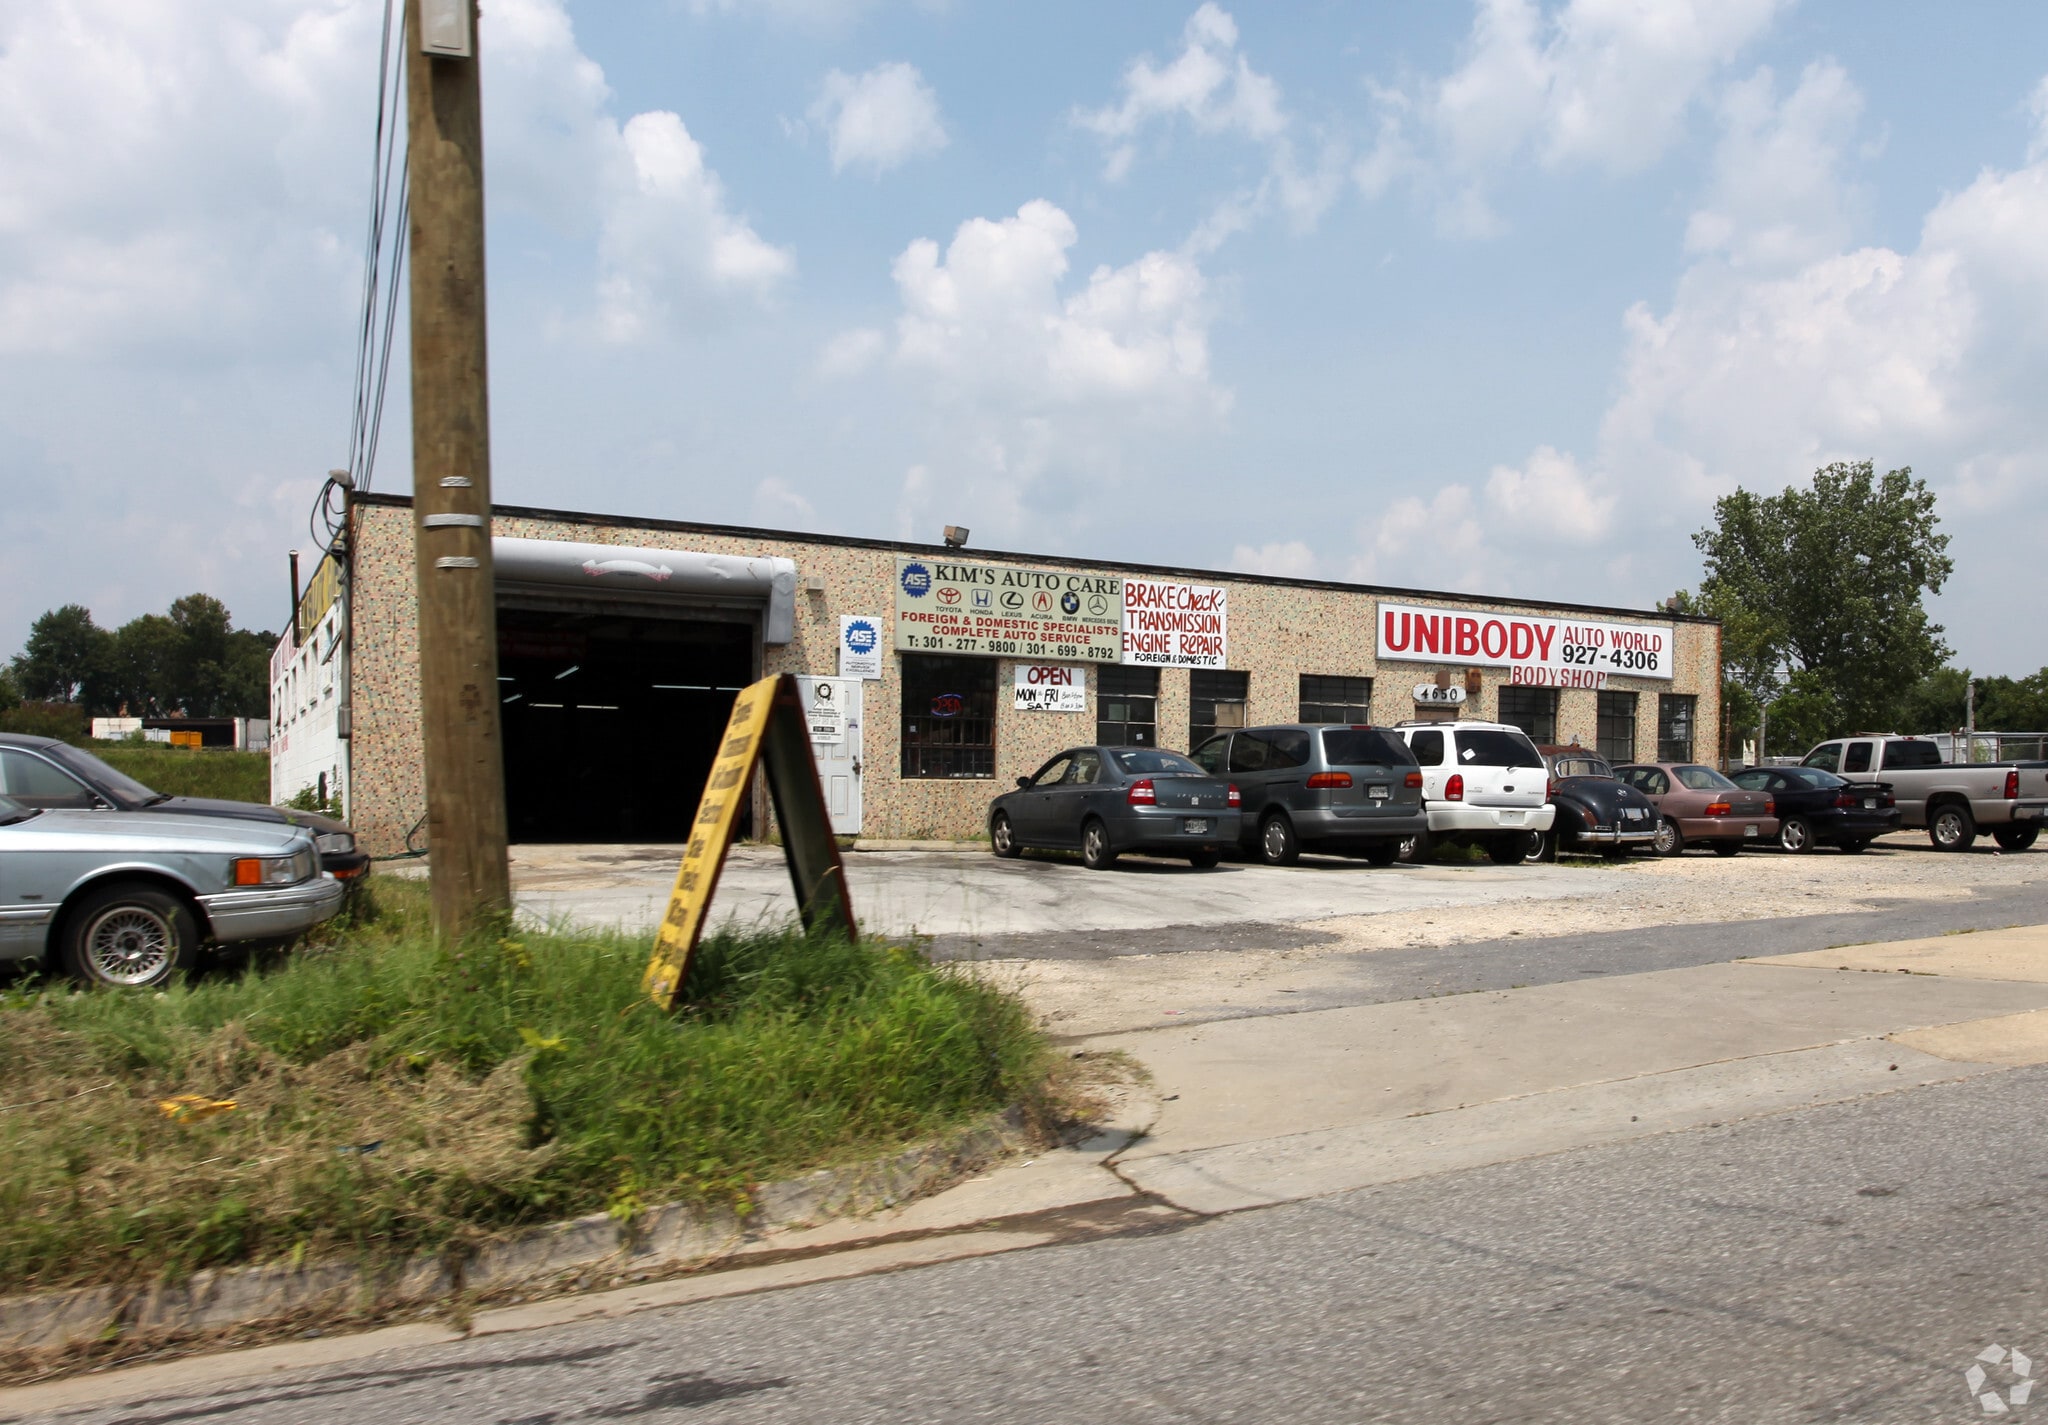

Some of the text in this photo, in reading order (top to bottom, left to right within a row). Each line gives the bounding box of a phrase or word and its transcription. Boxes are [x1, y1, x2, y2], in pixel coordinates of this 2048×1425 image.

[904, 573, 927, 586] ASE
[935, 565, 1120, 595] KIM'S AUTO CARE
[1125, 583, 1176, 609] BRAKE
[935, 605, 963, 613] TOYOTA
[969, 608, 994, 616] HONDA
[901, 611, 1119, 636] FOREIGN & DOMESTIC SPECIALISTS
[1126, 610, 1221, 634] TRANSMISSION
[848, 629, 873, 643] ASE
[932, 625, 1091, 645] COMPLETE AUTO SERVICE
[1122, 631, 1171, 654] ENGINE
[1385, 611, 1556, 661] UNIBODY
[1563, 626, 1662, 652] AUTO WORLD
[907, 635, 919, 647] T:
[923, 636, 943, 649] 301
[956, 638, 977, 651] 277
[988, 640, 1016, 653] 9800
[1026, 643, 1046, 655] 301
[1057, 645, 1077, 657] 699
[1088, 647, 1114, 659] 8792
[1135, 653, 1171, 664] FOREIGN
[1562, 644, 1658, 671] 927-4306
[1027, 666, 1072, 686] OPEN
[1015, 688, 1037, 702] MON
[1044, 688, 1059, 702] FRI
[1420, 688, 1458, 700] 4650
[1027, 702, 1051, 710] SAT
